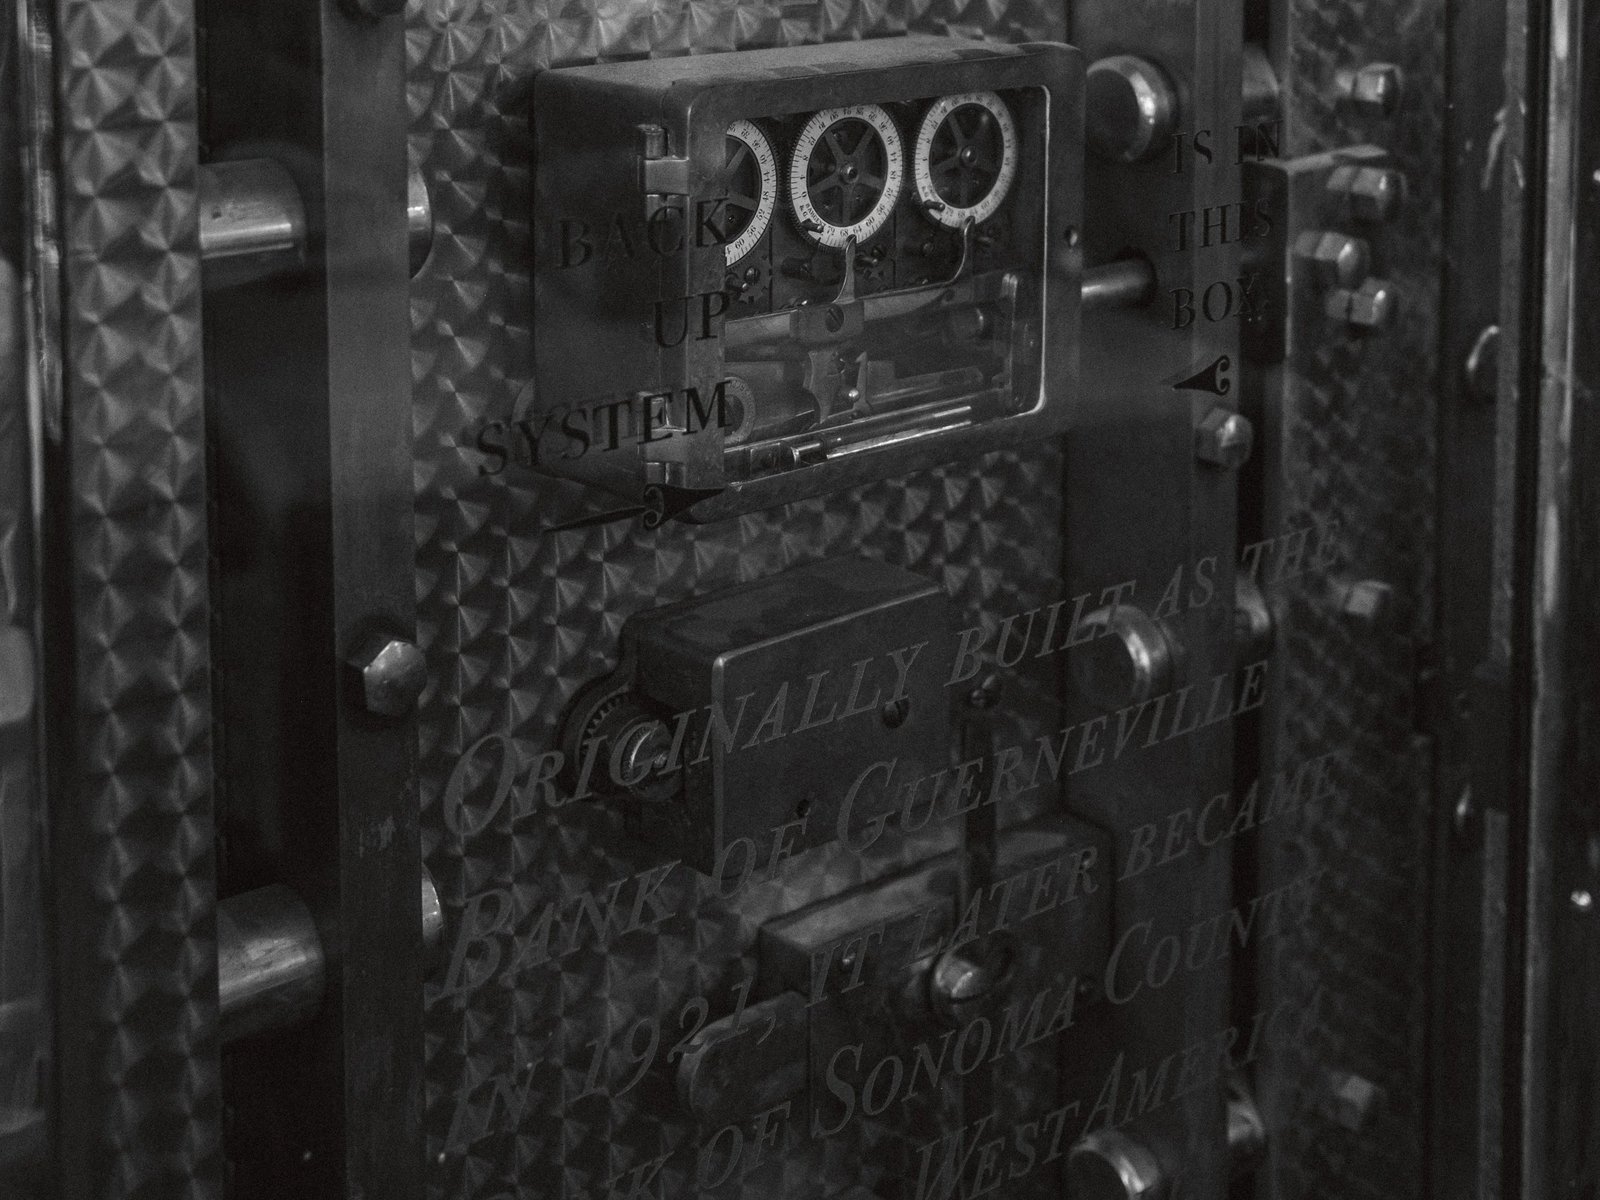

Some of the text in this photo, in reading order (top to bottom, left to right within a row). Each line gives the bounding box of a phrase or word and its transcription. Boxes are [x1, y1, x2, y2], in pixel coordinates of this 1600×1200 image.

[1169, 119, 1284, 175] IS IN
[558, 196, 729, 270] BACK
[1168, 201, 1274, 252] THIS
[654, 290, 731, 349] UP
[1168, 273, 1262, 331] BOX
[474, 379, 732, 477] SYSTEM
[443, 640, 931, 838] ORIGINALLY
[943, 578, 1138, 689] BUILT
[1148, 555, 1218, 621] AS
[434, 659, 1270, 1000] BANK OF GUERNEVILLE
[443, 751, 1340, 1153] IN 1921, IT LATER BECAME
[702, 1099, 792, 1190] OF
[811, 975, 1076, 1139] SONOMA
